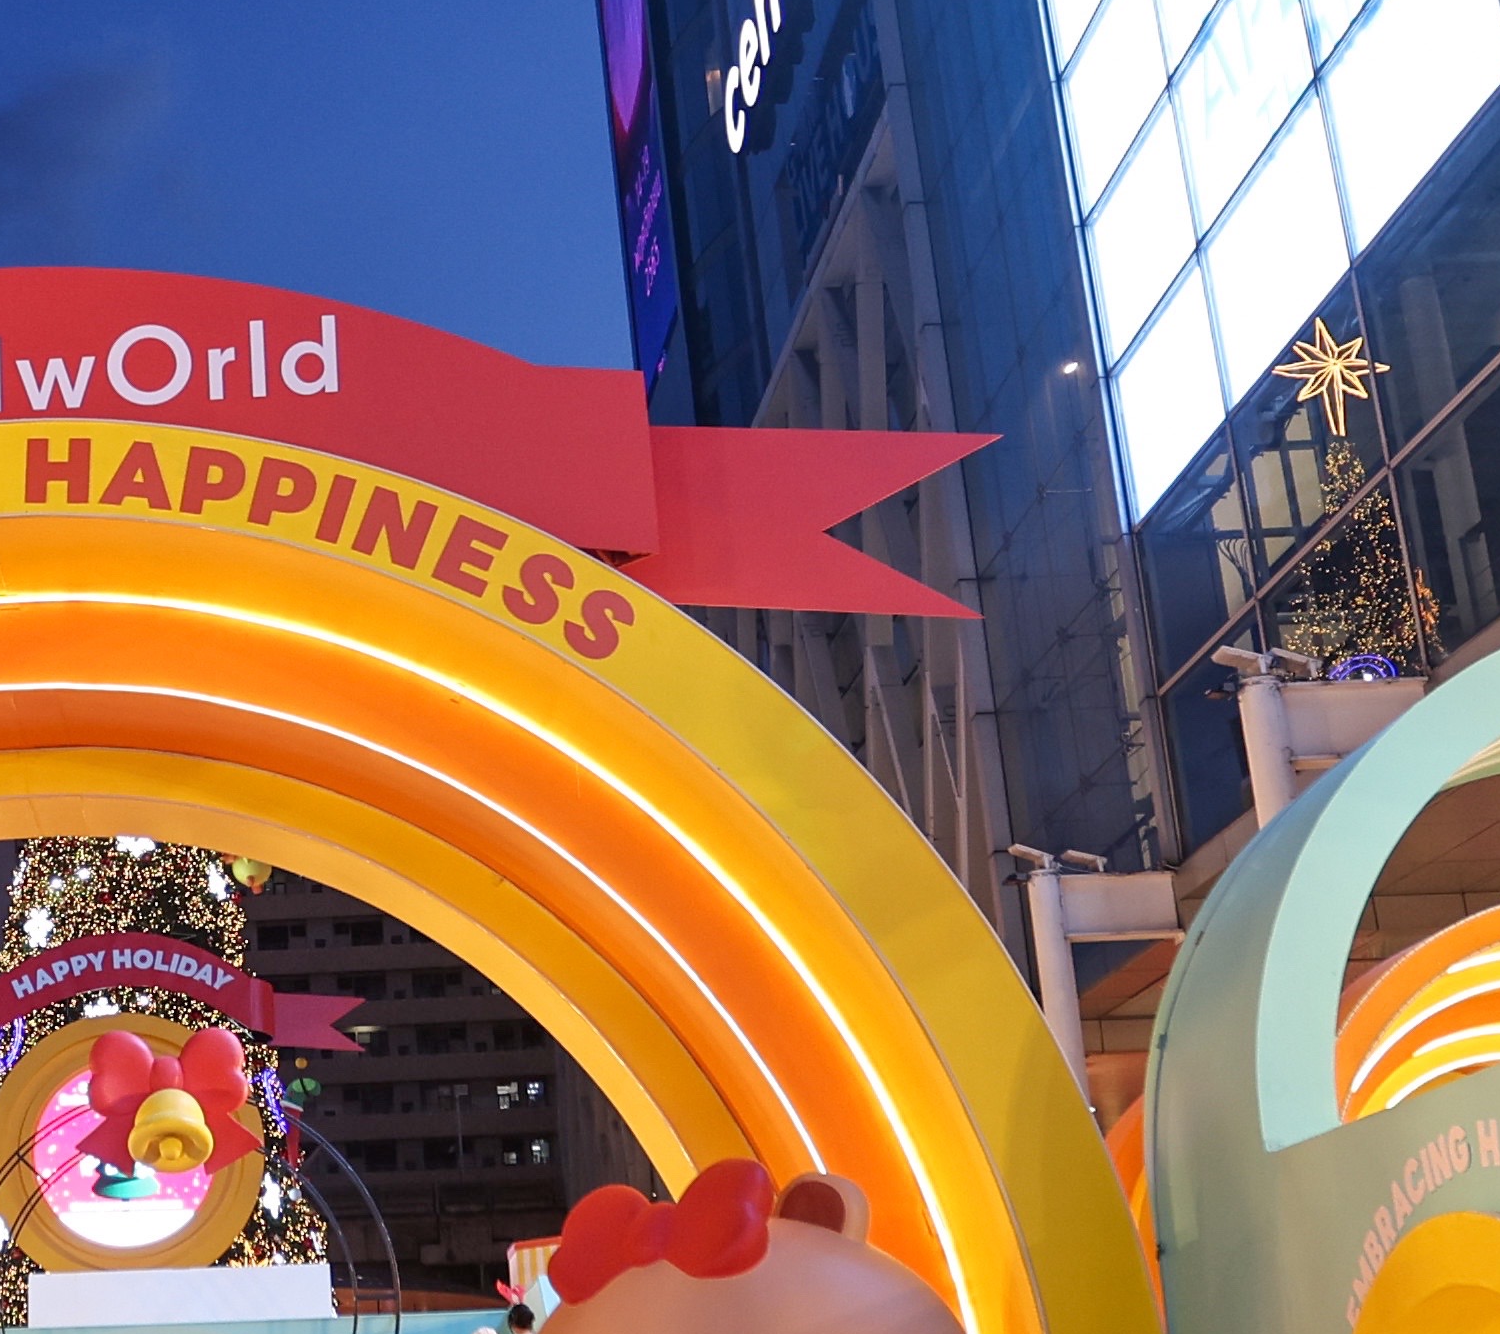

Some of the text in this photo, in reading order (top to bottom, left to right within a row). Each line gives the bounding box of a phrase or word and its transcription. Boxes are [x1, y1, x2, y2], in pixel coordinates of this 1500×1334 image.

[24, 437, 637, 663] HAPPINESS
[11, 948, 235, 1000] HAPPY HOLIDAY
